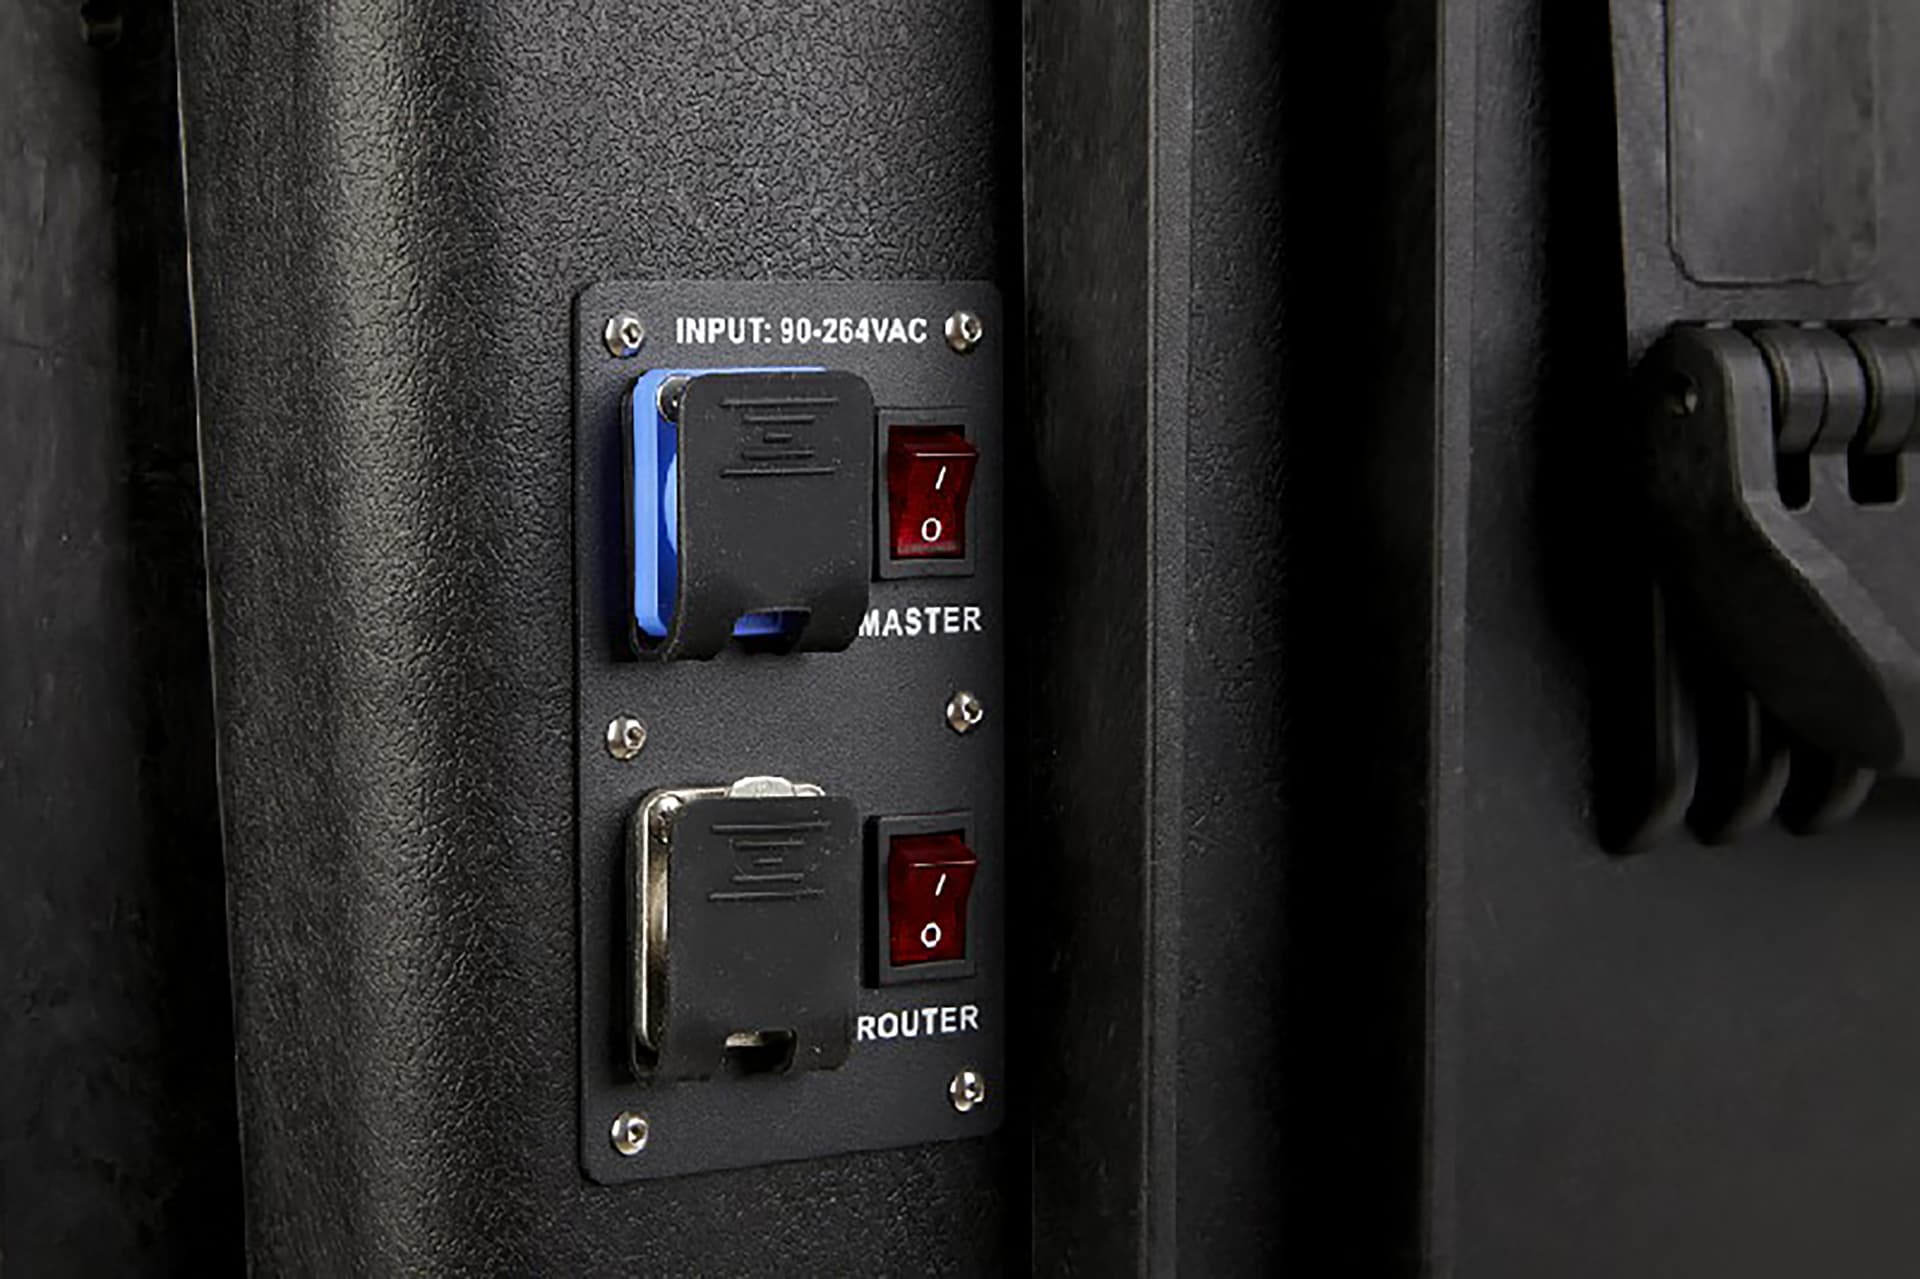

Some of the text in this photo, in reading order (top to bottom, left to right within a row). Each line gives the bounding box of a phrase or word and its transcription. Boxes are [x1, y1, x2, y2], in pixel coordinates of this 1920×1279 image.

[675, 316, 928, 345] INPUT: 90-264VAC
[858, 606, 982, 638] MASTER
[856, 1004, 979, 1042] ROUTER
